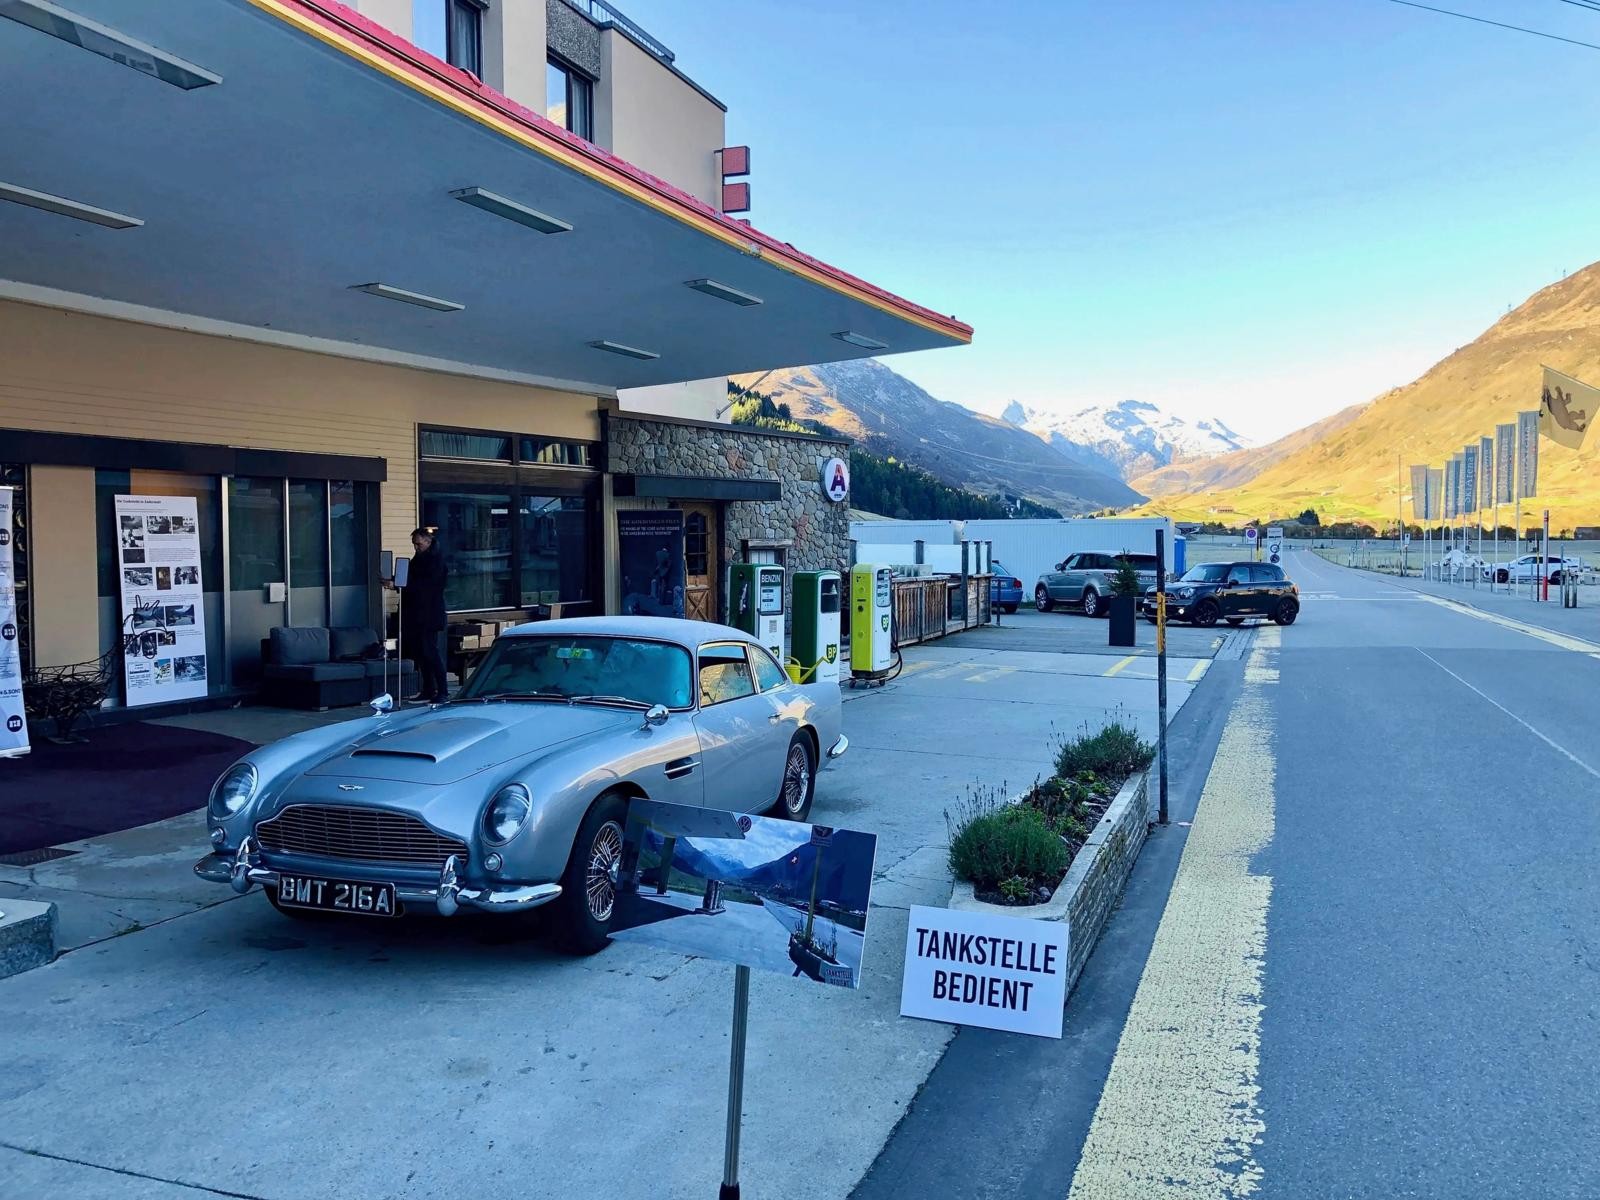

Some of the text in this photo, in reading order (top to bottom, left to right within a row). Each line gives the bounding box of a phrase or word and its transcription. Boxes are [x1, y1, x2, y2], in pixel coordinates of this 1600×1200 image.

[761, 574, 781, 583] BENZIN
[882, 617, 889, 628] BP
[827, 646, 837, 659] BP
[280, 877, 390, 913] BMT 216A
[916, 928, 1058, 975] TANKSTELLE
[933, 970, 1034, 1012] BEDIENT
